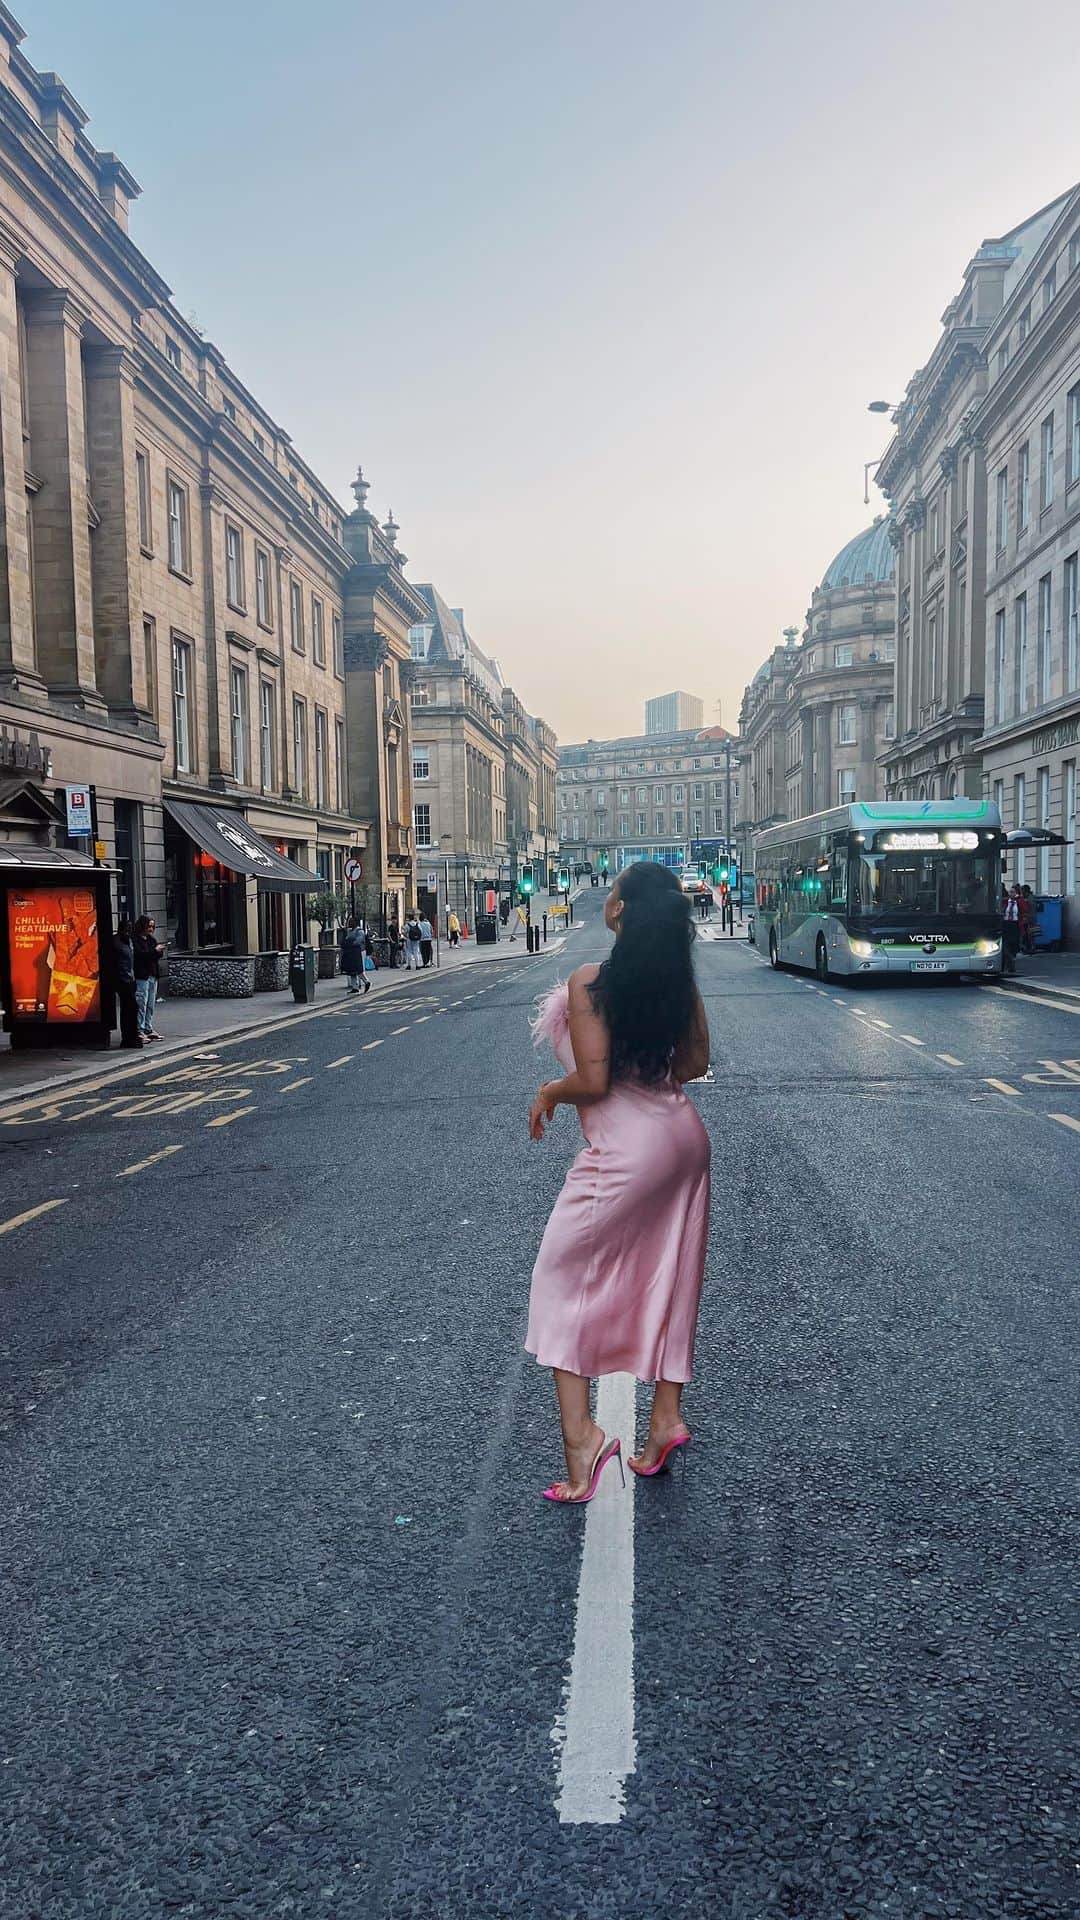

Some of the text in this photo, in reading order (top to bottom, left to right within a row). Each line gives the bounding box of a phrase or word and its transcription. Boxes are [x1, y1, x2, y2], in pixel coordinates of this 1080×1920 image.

[1032, 720, 1079, 755] LLOYDS BANK
[73, 794, 82, 804] B
[16, 917, 45, 925] CHILLI
[15, 925, 67, 934] HEATWAVE
[909, 934, 950, 942] VOLTRA
[144, 1057, 308, 1086] BUS
[1, 1088, 252, 1125] STOP
